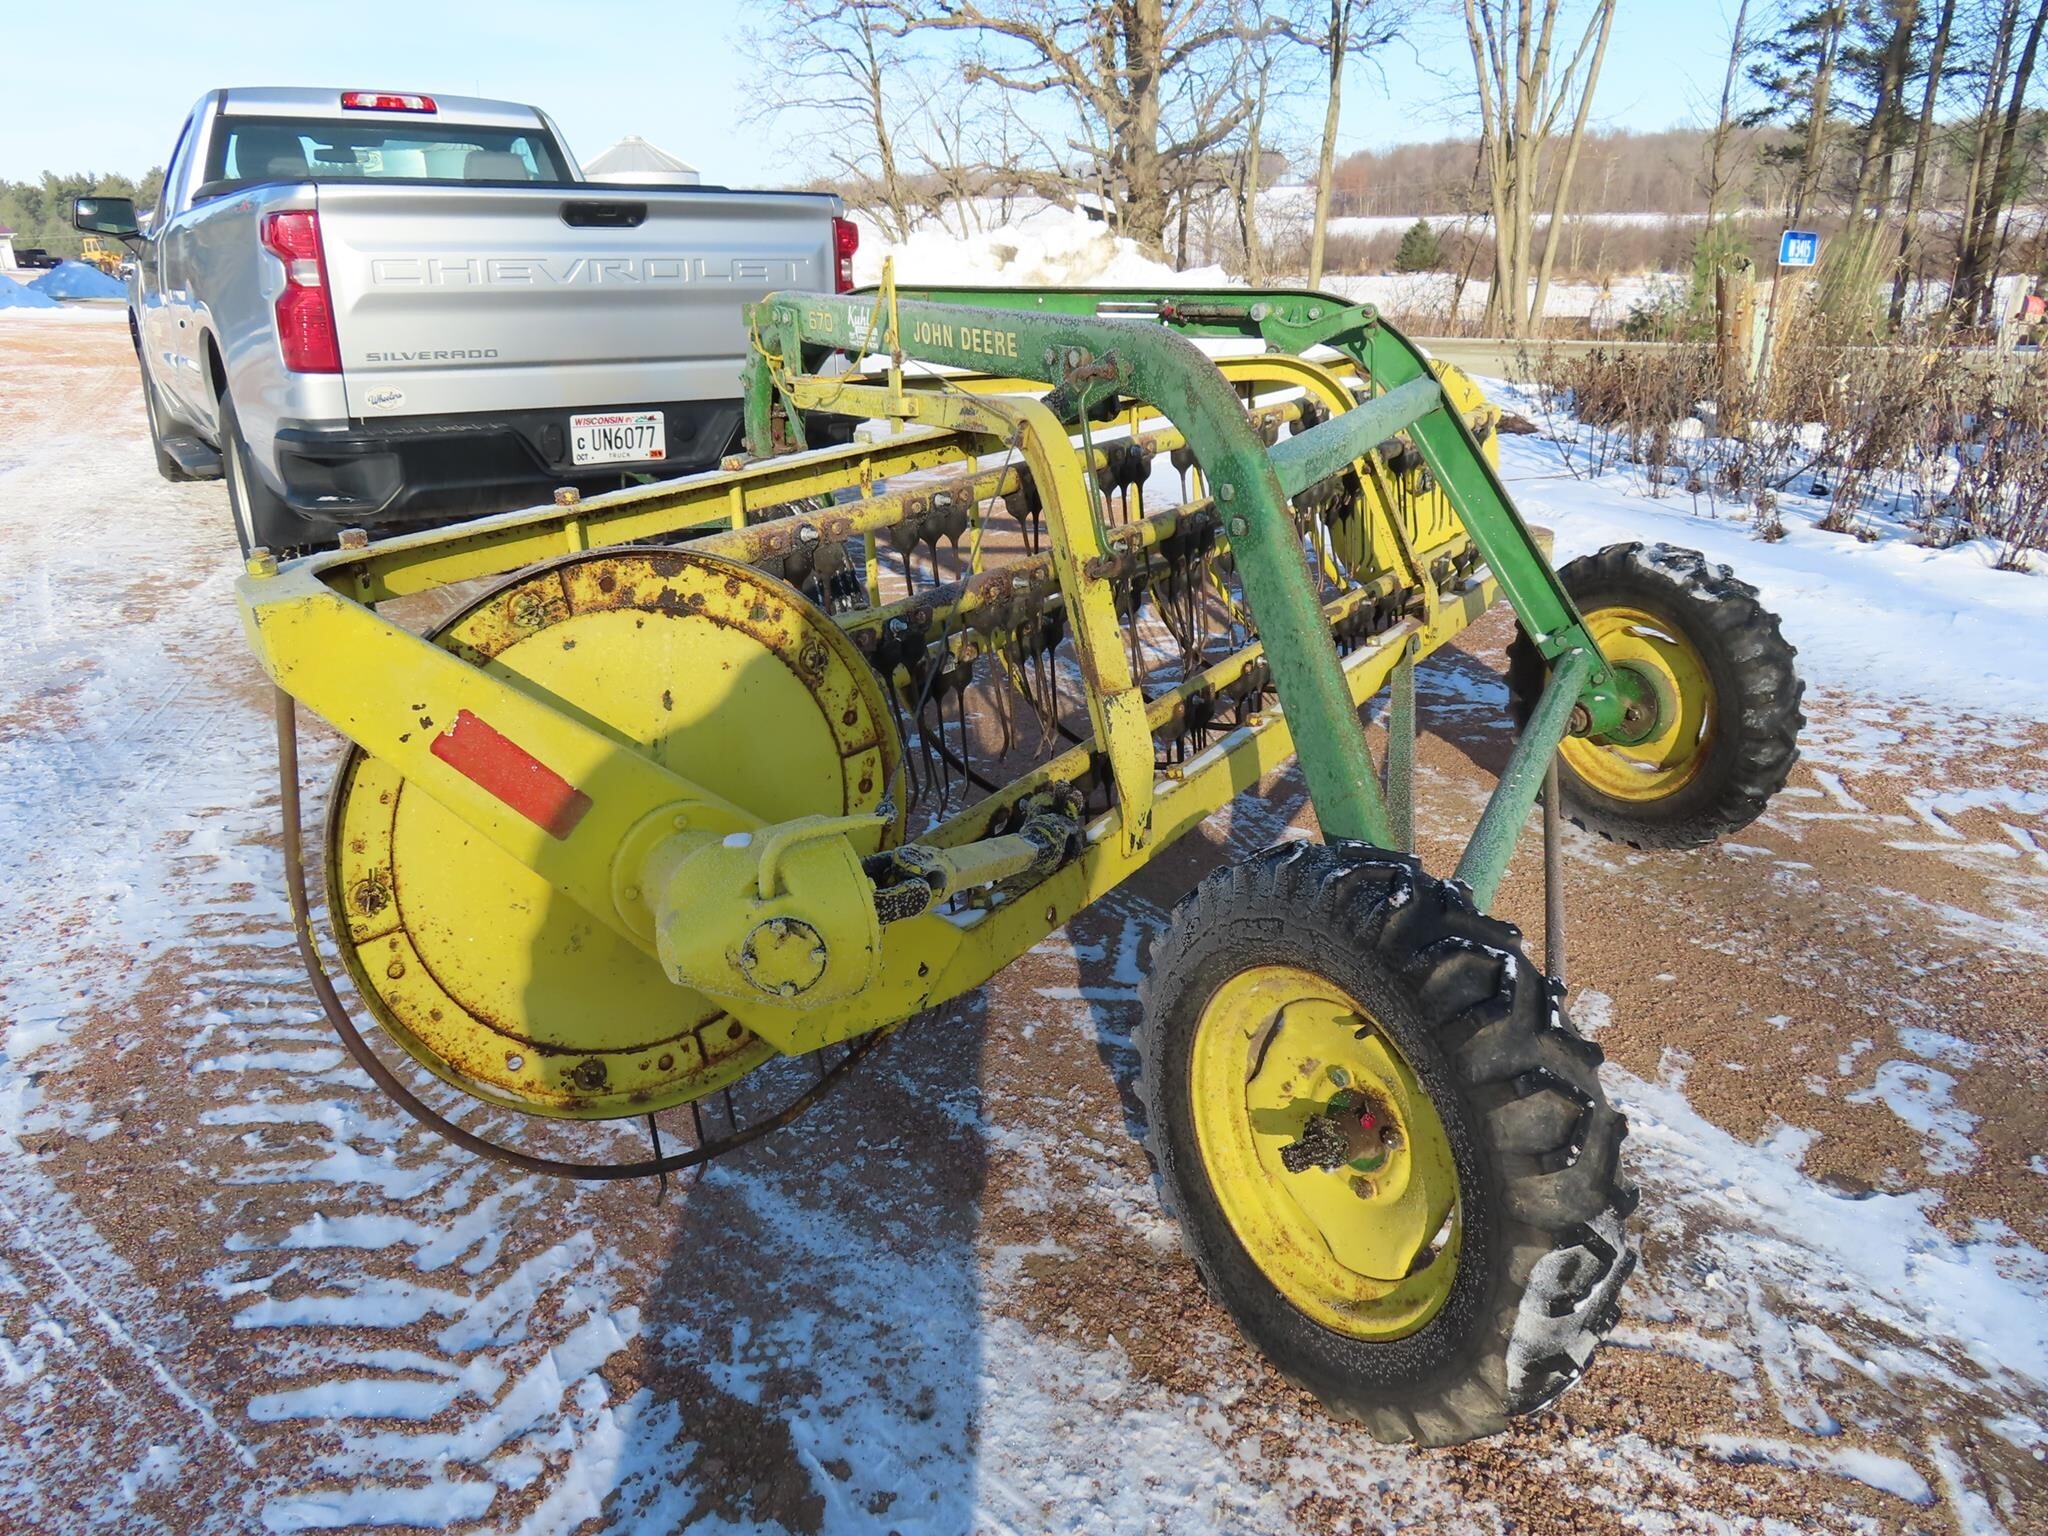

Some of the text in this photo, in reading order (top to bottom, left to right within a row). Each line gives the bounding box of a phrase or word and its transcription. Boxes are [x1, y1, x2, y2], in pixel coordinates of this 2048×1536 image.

[370, 257, 808, 285] CHEVROLET
[808, 311, 833, 332] 670
[913, 321, 953, 348] JOHN
[960, 326, 1018, 358] DEERE
[366, 349, 498, 361] SILVERADO
[575, 416, 624, 426] WISCONSIN
[577, 426, 655, 451] C UN6077
[576, 453, 588, 461] OCT
